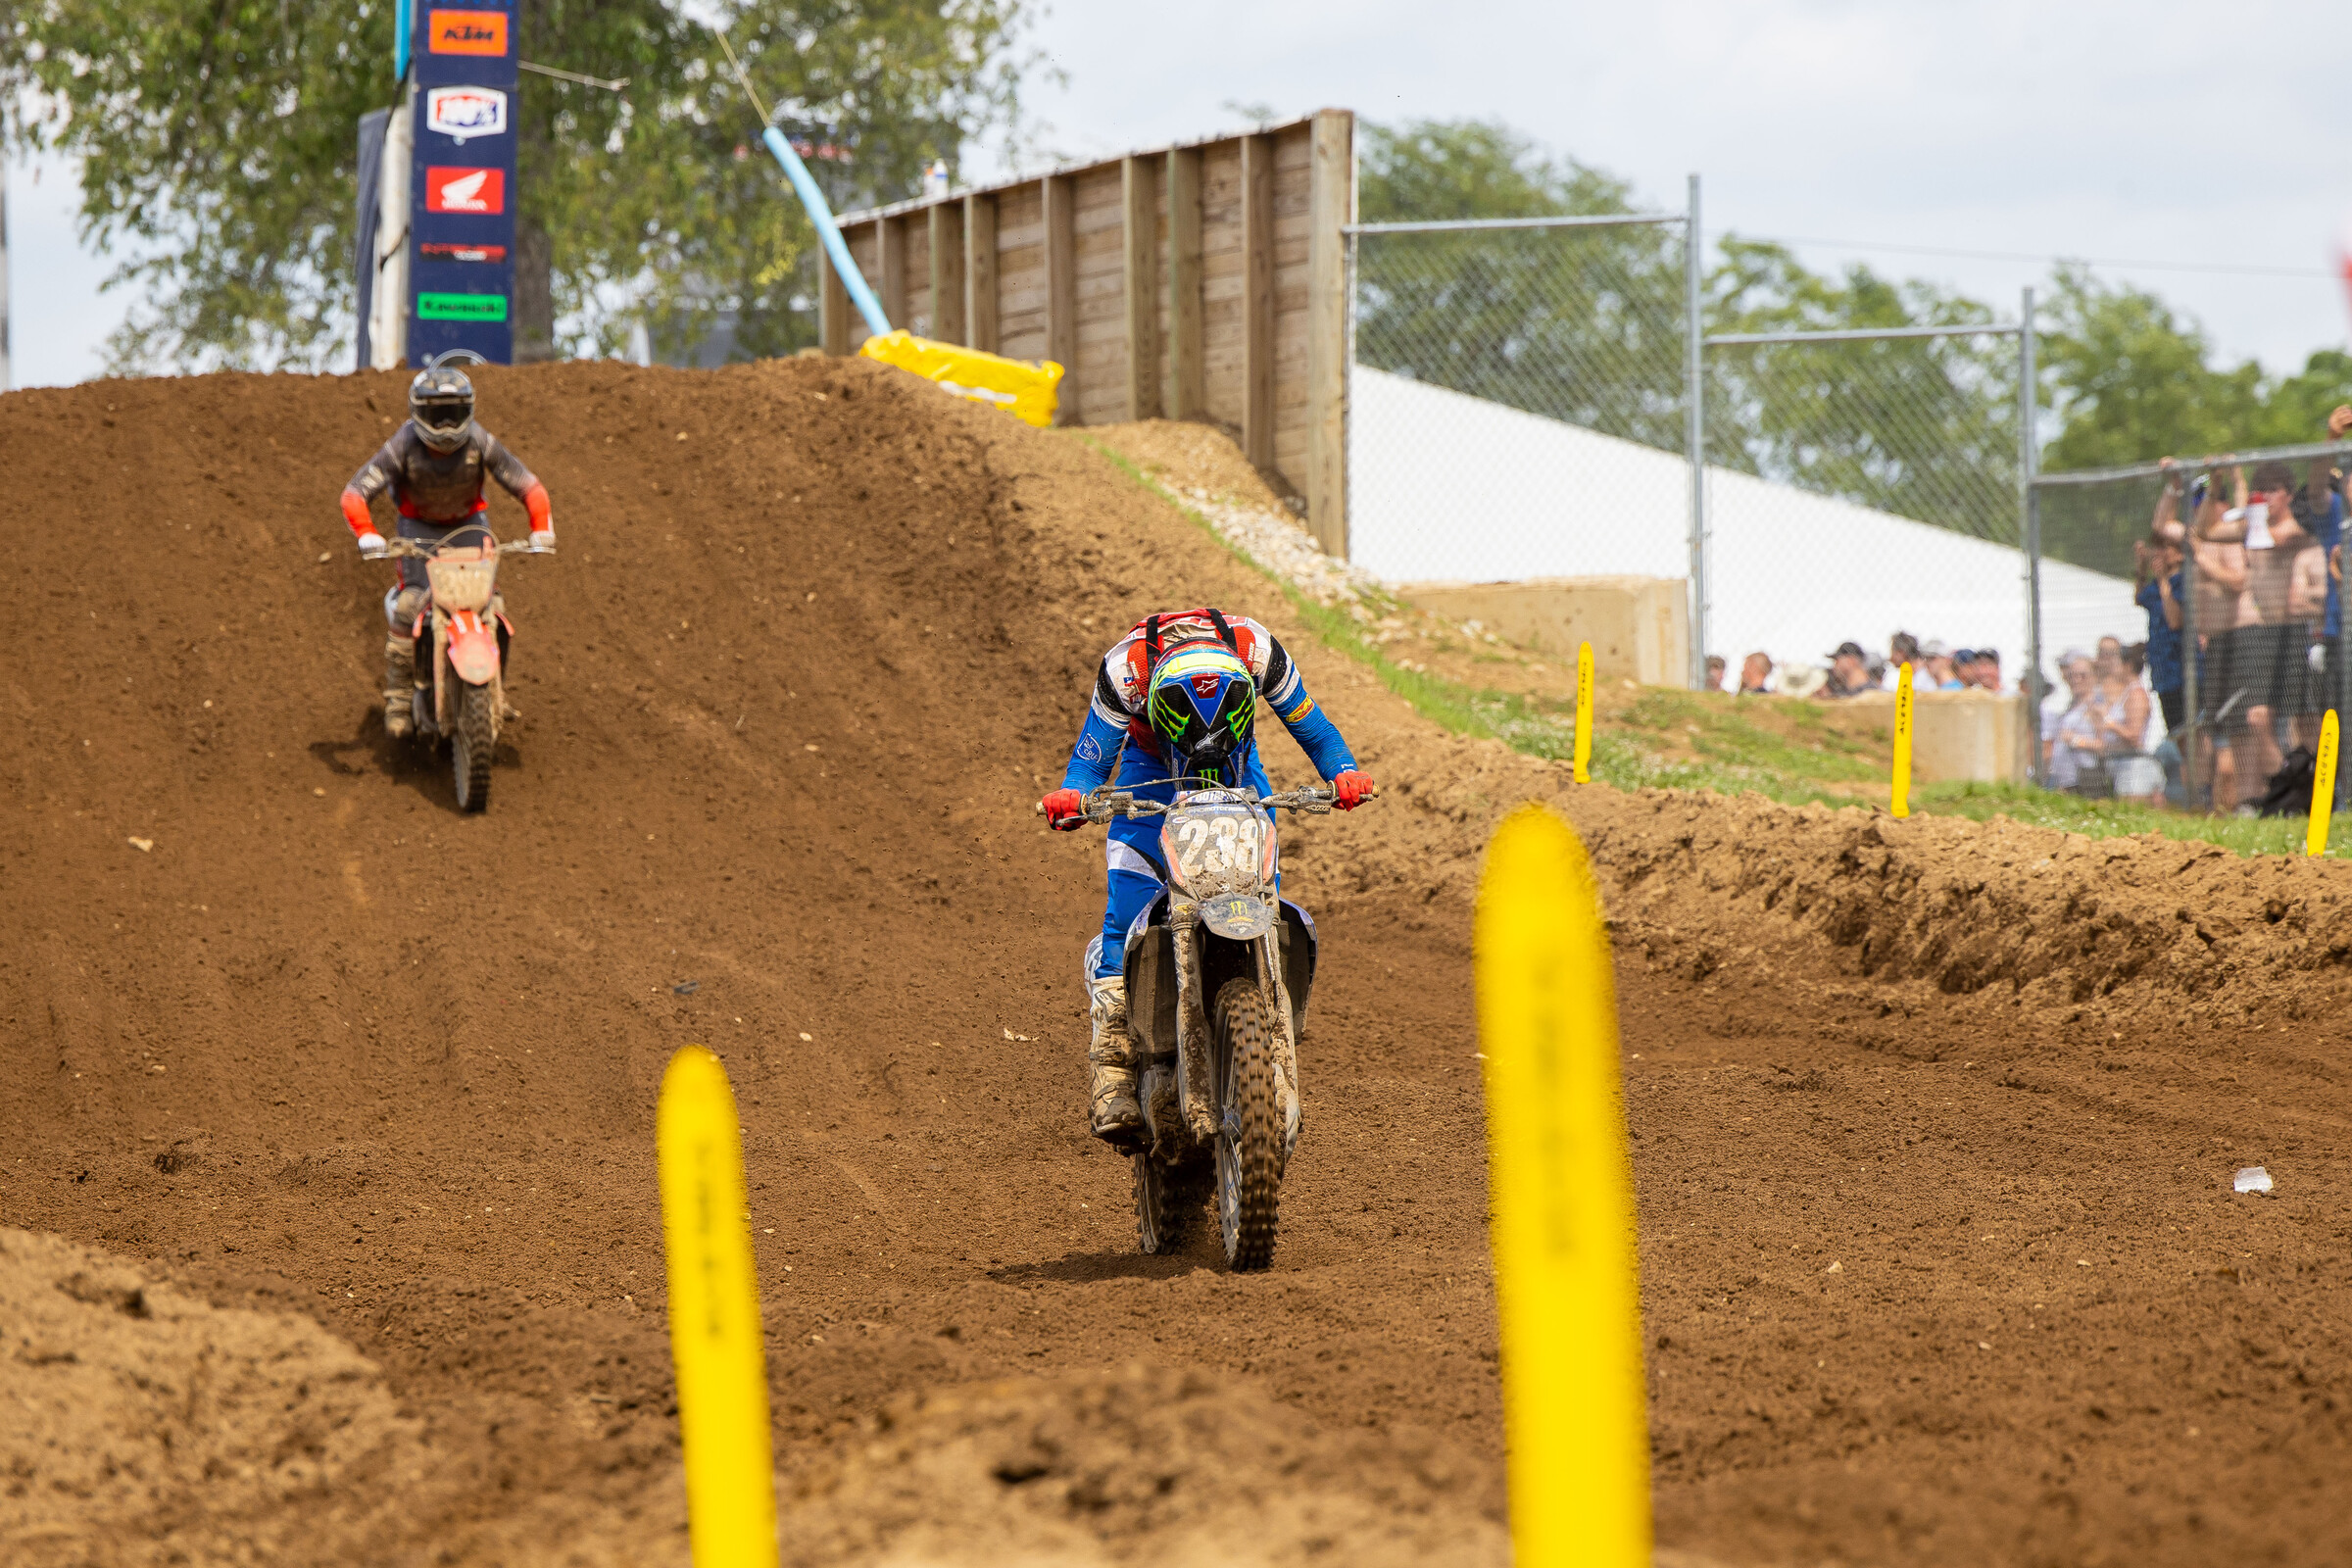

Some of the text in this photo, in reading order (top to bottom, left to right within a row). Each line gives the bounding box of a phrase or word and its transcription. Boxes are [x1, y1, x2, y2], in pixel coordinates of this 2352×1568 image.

[1248, 642, 1256, 662] THOR
[1129, 661, 1141, 679] THOR
[1178, 816, 1267, 877] 238
